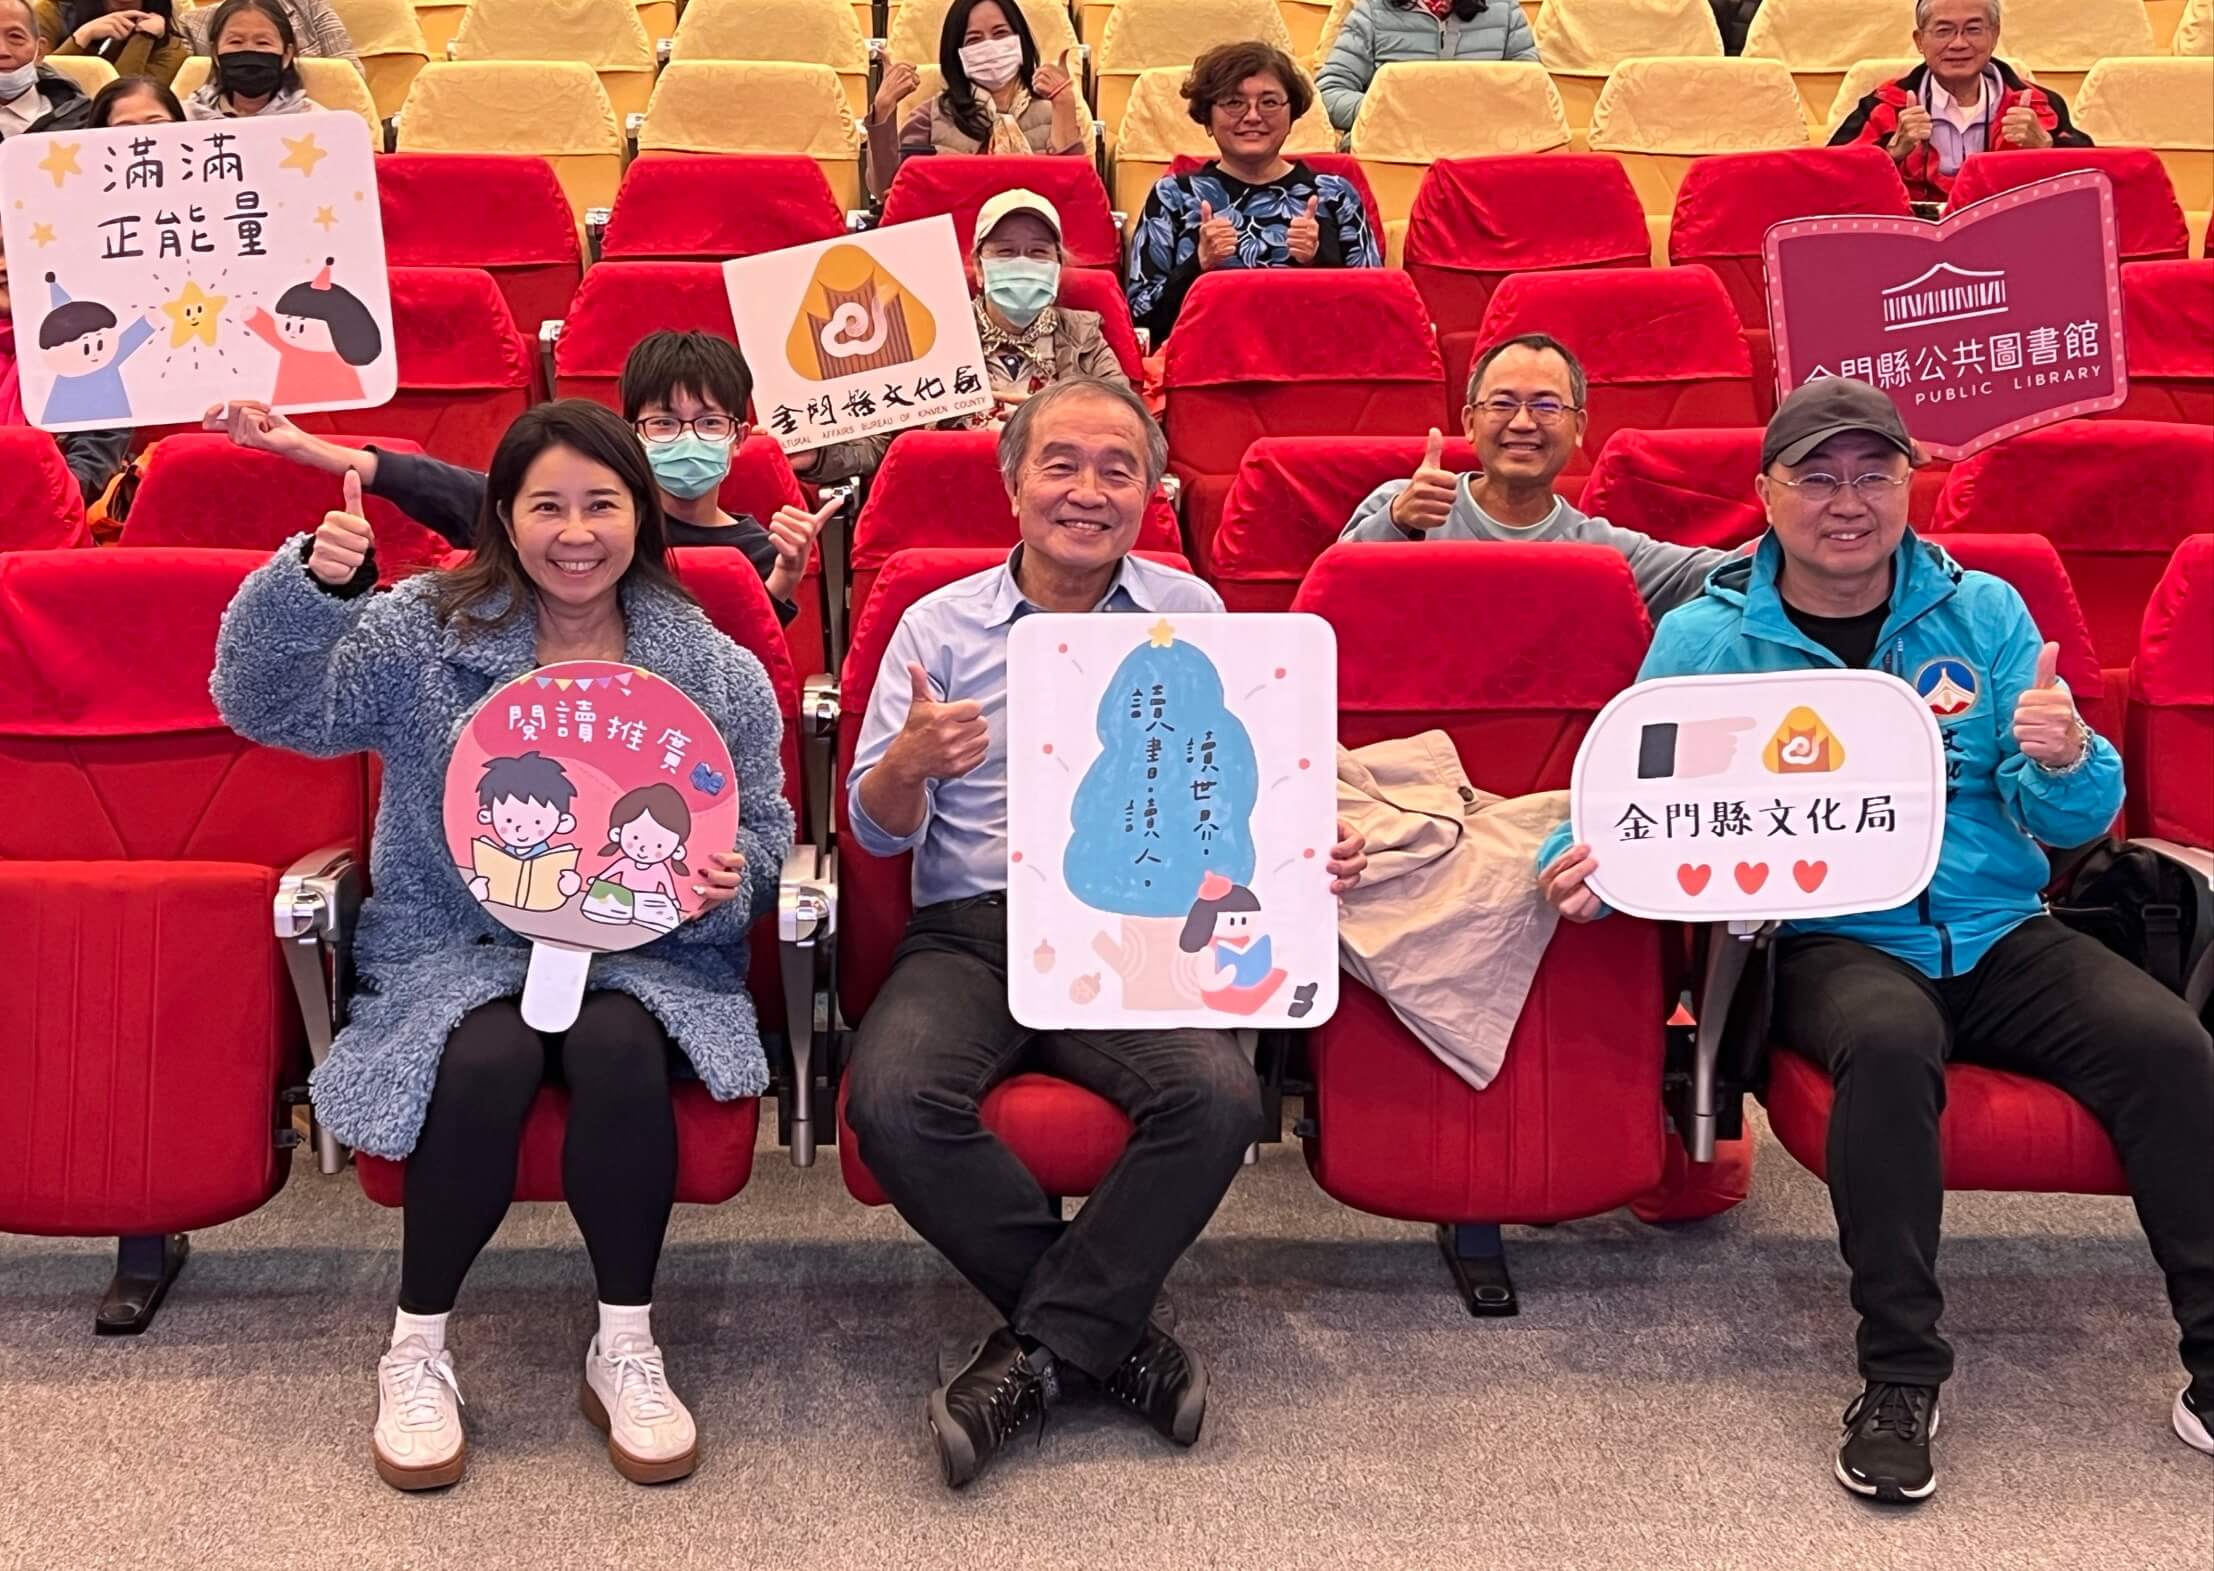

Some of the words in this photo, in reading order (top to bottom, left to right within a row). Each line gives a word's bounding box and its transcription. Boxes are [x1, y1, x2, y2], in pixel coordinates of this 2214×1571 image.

[104, 132, 244, 193] 滿滿
[97, 190, 269, 259] 正能量
[770, 364, 983, 435] 金門縣文化局
[1914, 381, 1994, 407] PUBLIC
[2013, 364, 2102, 391] LIBRARY
[781, 435, 812, 449] LTURAL
[821, 426, 855, 440] AFFAIRS
[861, 417, 894, 431] BUREAU
[899, 411, 911, 423] OF
[954, 396, 986, 410] COUNTY
[508, 699, 693, 776] 閱讀推廣
[1614, 794, 1896, 842] 金門縣文化局
